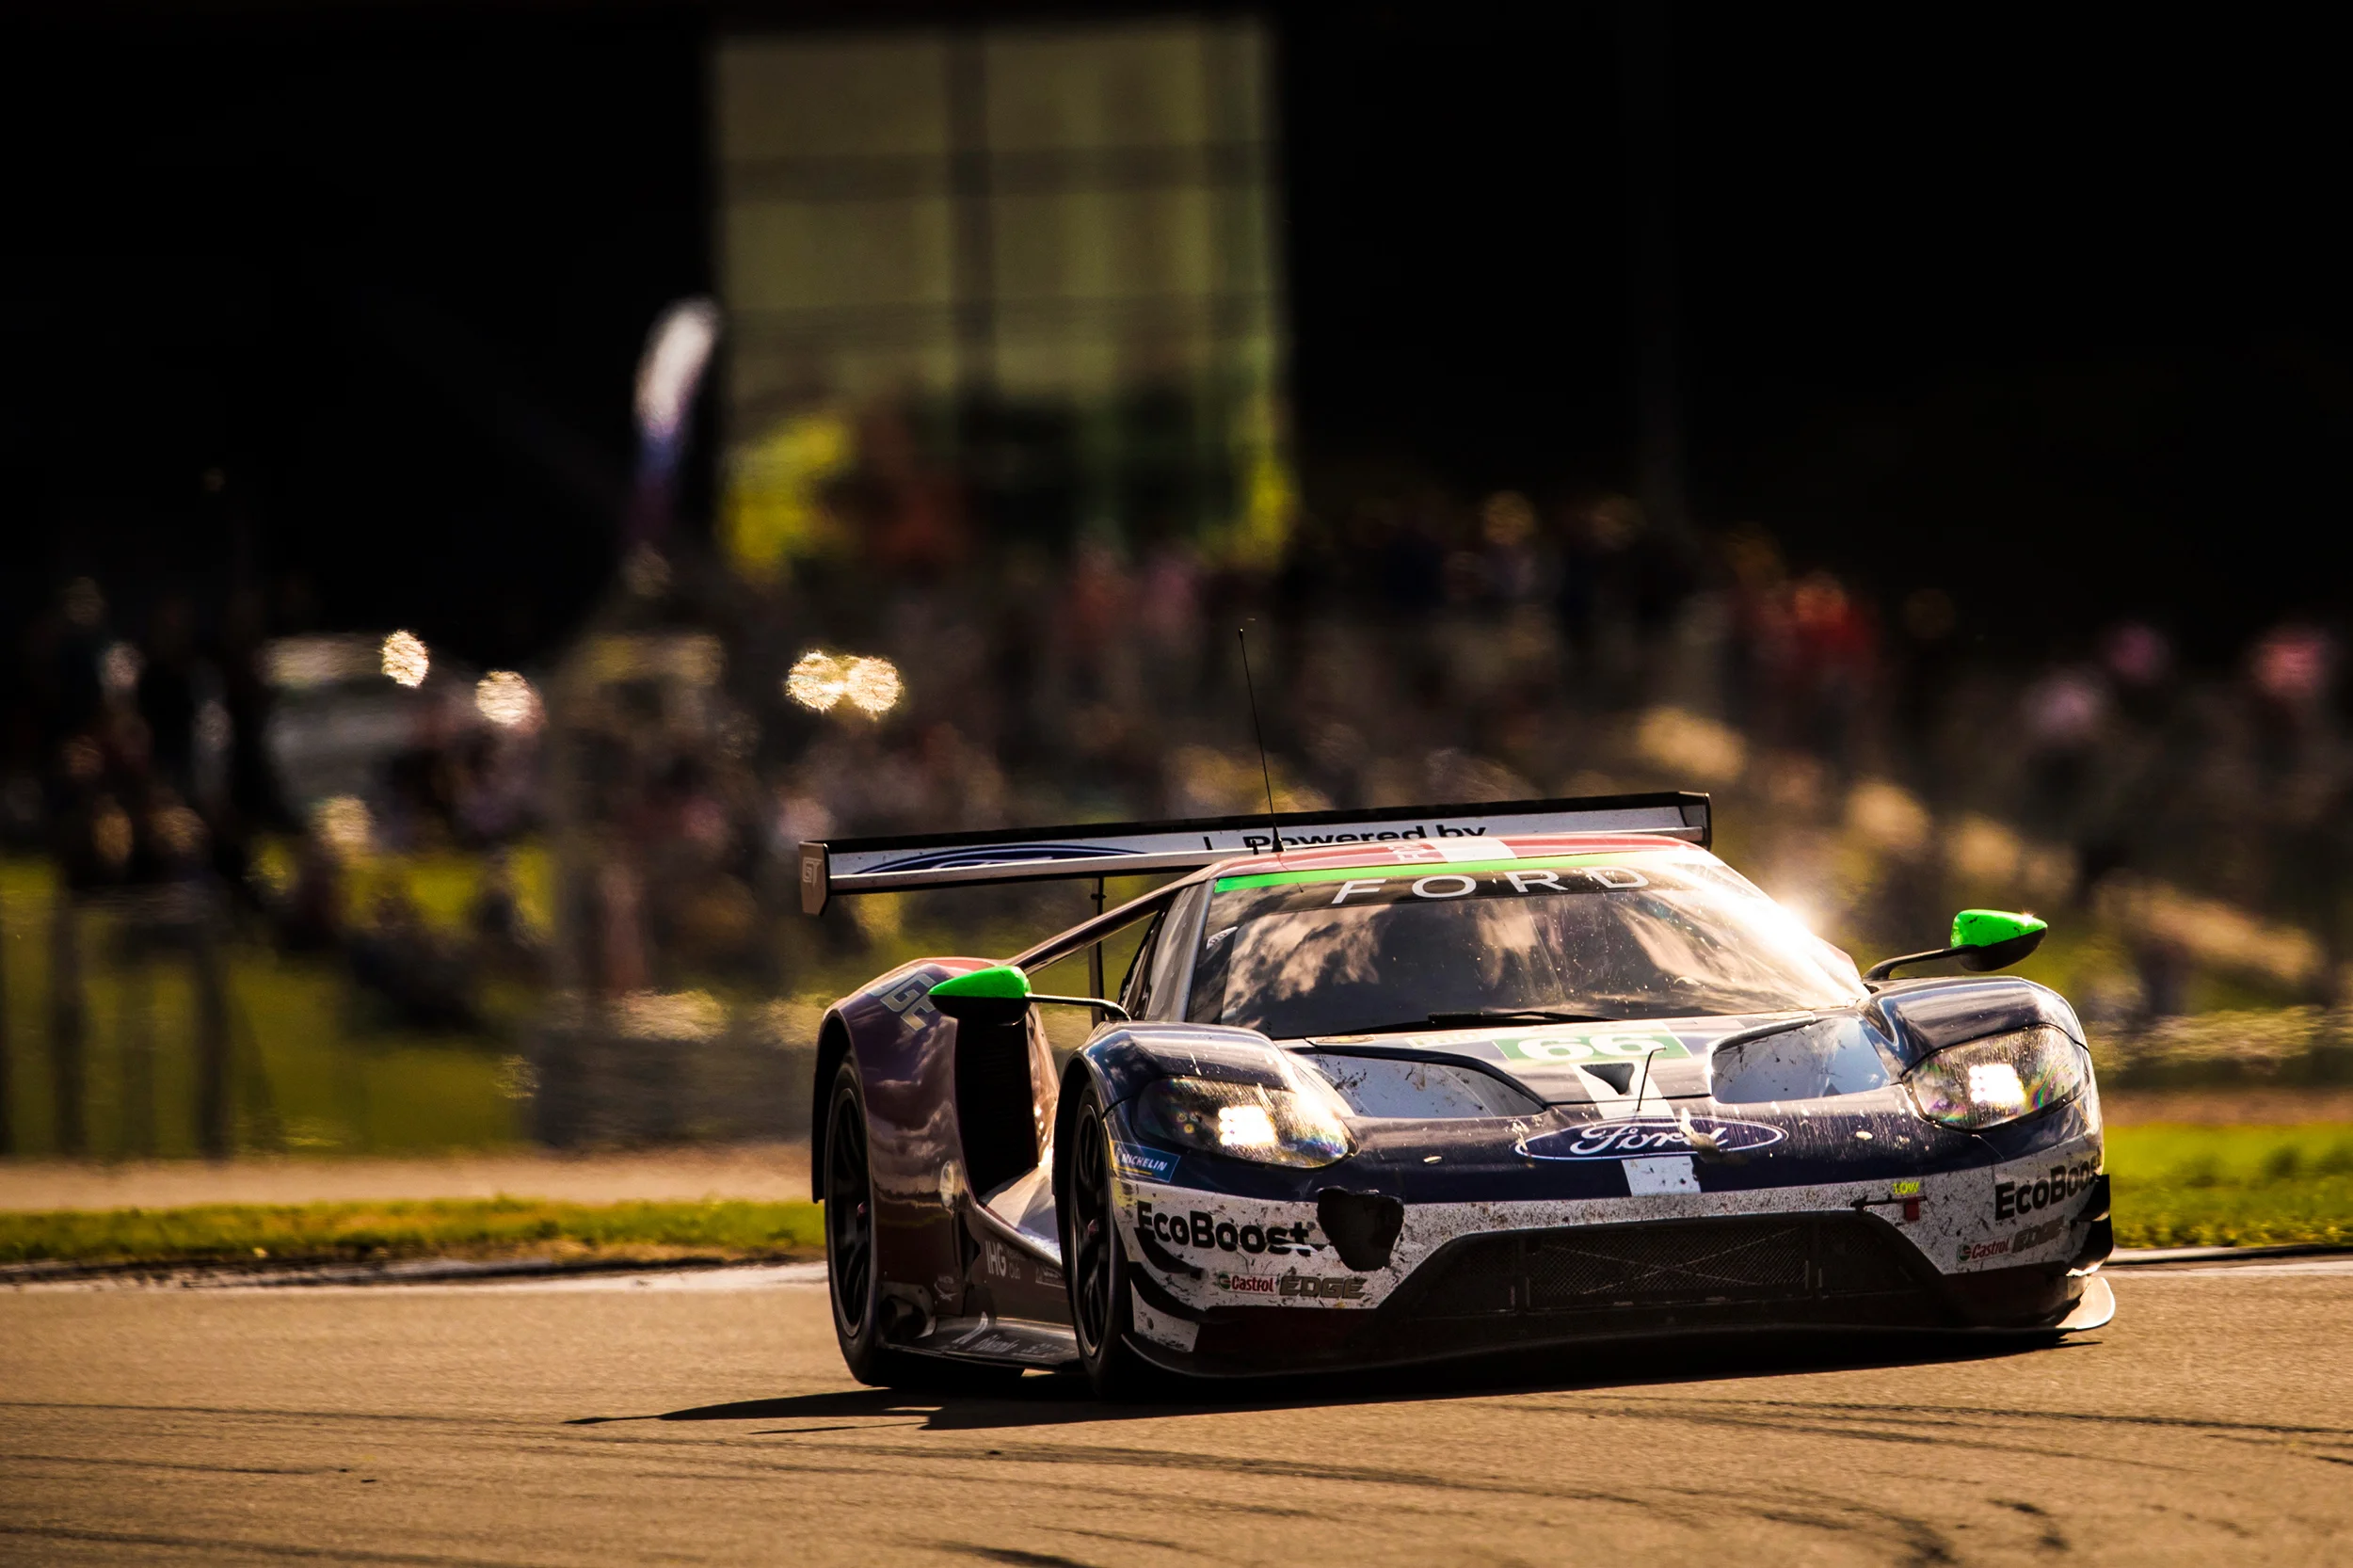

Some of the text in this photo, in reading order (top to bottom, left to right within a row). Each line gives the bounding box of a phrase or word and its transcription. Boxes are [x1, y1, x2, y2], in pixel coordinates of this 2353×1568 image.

[1331, 866, 1649, 904] FORD
[1517, 1033, 1662, 1061] 66
[1570, 1125, 1728, 1156] Ford
[1121, 1153, 1169, 1171] MICHELIN
[1136, 1200, 1312, 1256] EcoBoost
[985, 1240, 1007, 1278] IHG
[1972, 1238, 2009, 1258] Castrol
[1231, 1274, 1368, 1300] Castrol EDGE
